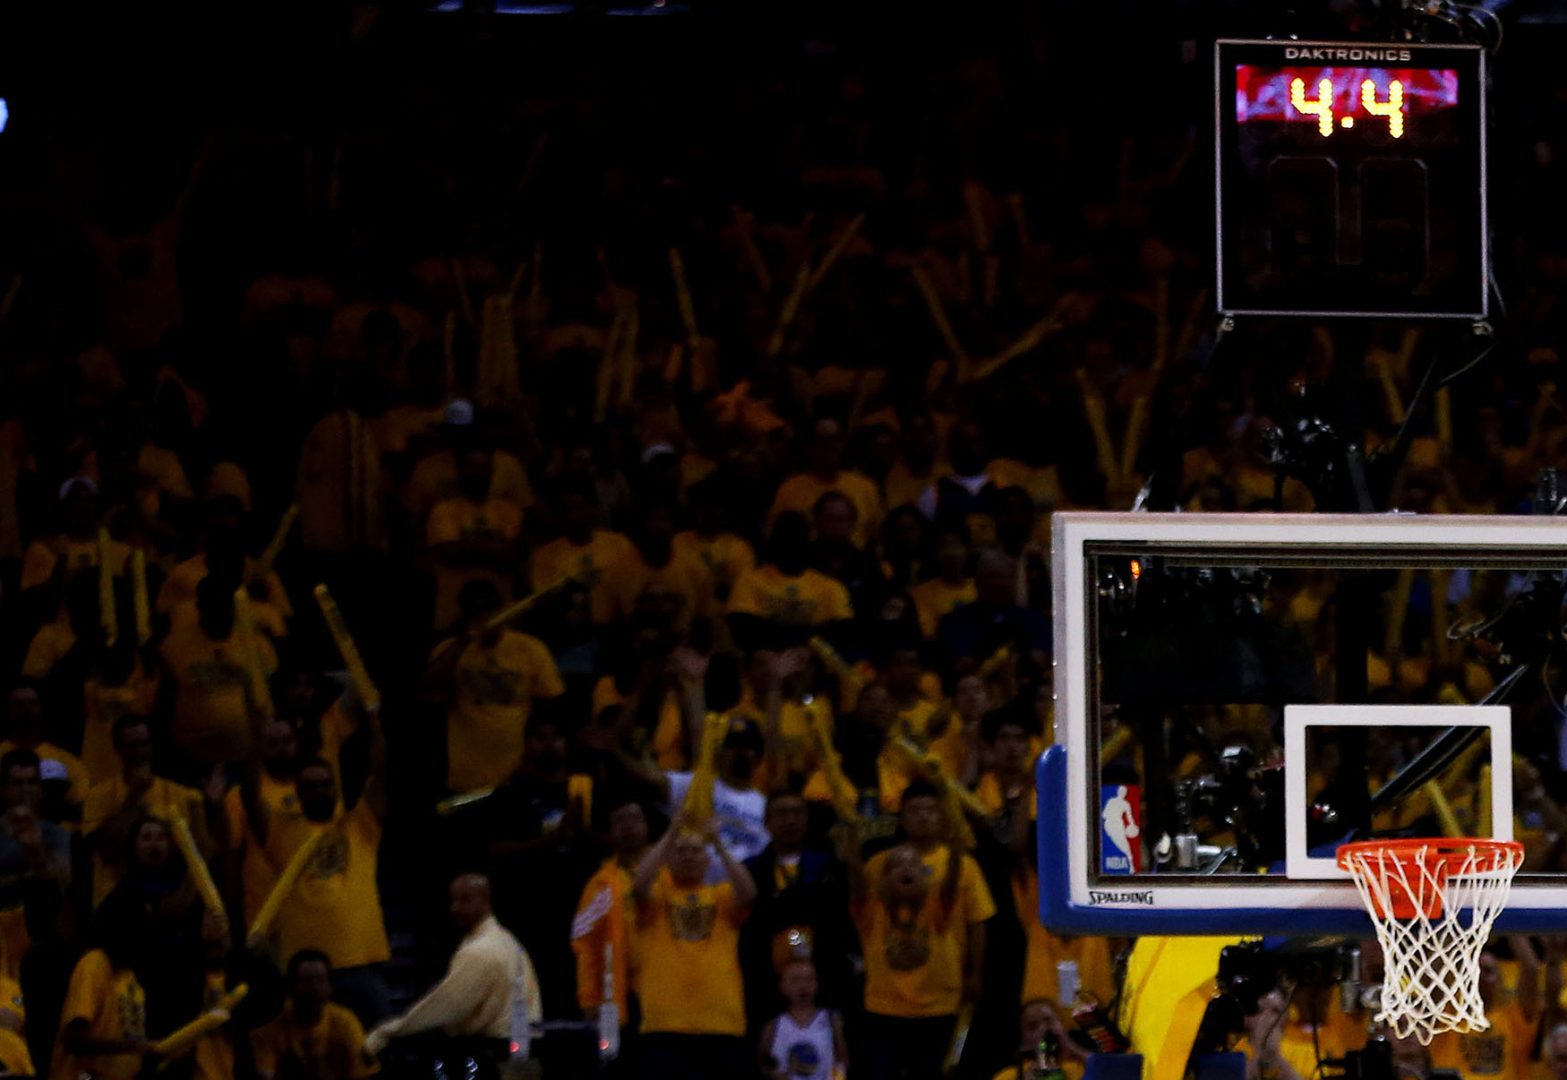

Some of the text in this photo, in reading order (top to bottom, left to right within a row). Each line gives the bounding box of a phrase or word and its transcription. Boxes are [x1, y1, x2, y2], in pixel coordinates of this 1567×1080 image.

[1285, 48, 1411, 61] DAKTRONICS
[1291, 77, 1403, 138] 4.4
[1089, 890, 1154, 905] SPALDING
